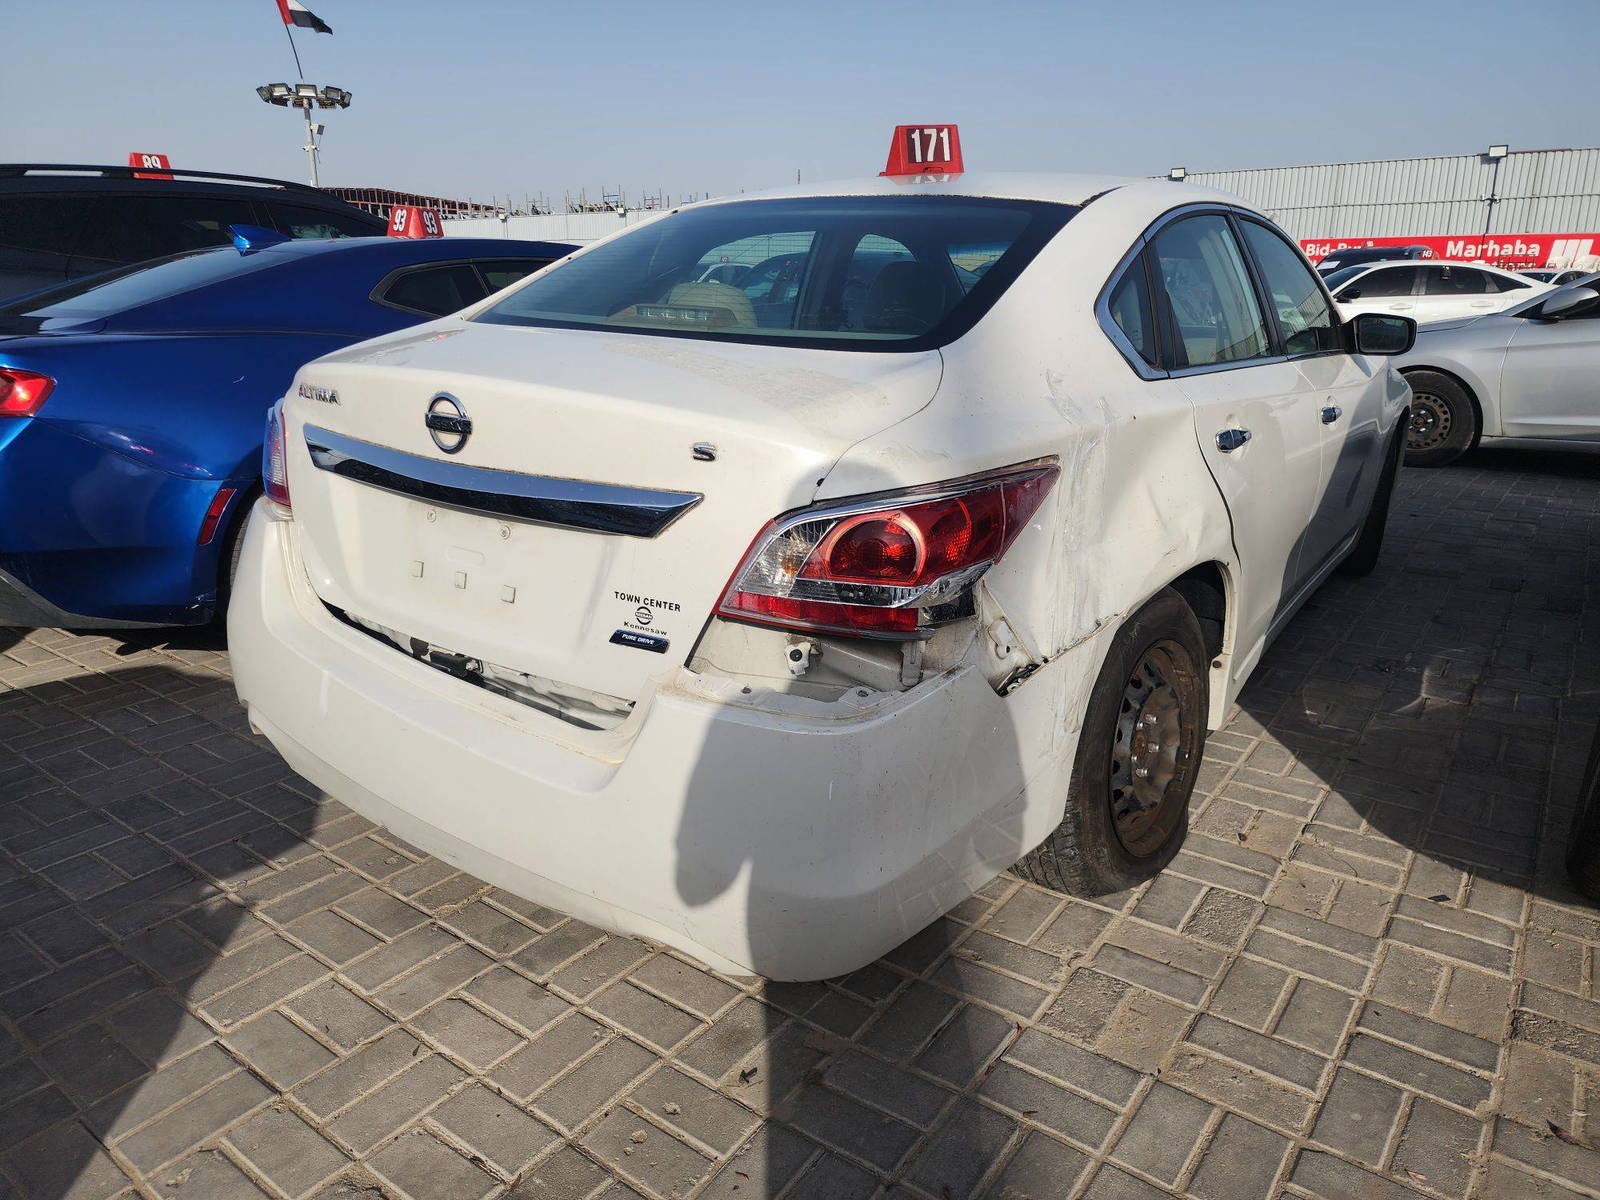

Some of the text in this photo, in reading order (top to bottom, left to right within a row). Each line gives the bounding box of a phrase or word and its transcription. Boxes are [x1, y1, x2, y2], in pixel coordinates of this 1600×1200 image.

[911, 127, 951, 163] 171
[142, 154, 162, 169] 89
[393, 208, 407, 232] 93
[423, 210, 438, 234] 93
[1445, 239, 1541, 258] Marhaba
[298, 384, 341, 405] ALTIMA
[614, 591, 681, 612] TOWN CENTER
[621, 633, 655, 645] PURE DRIVE
